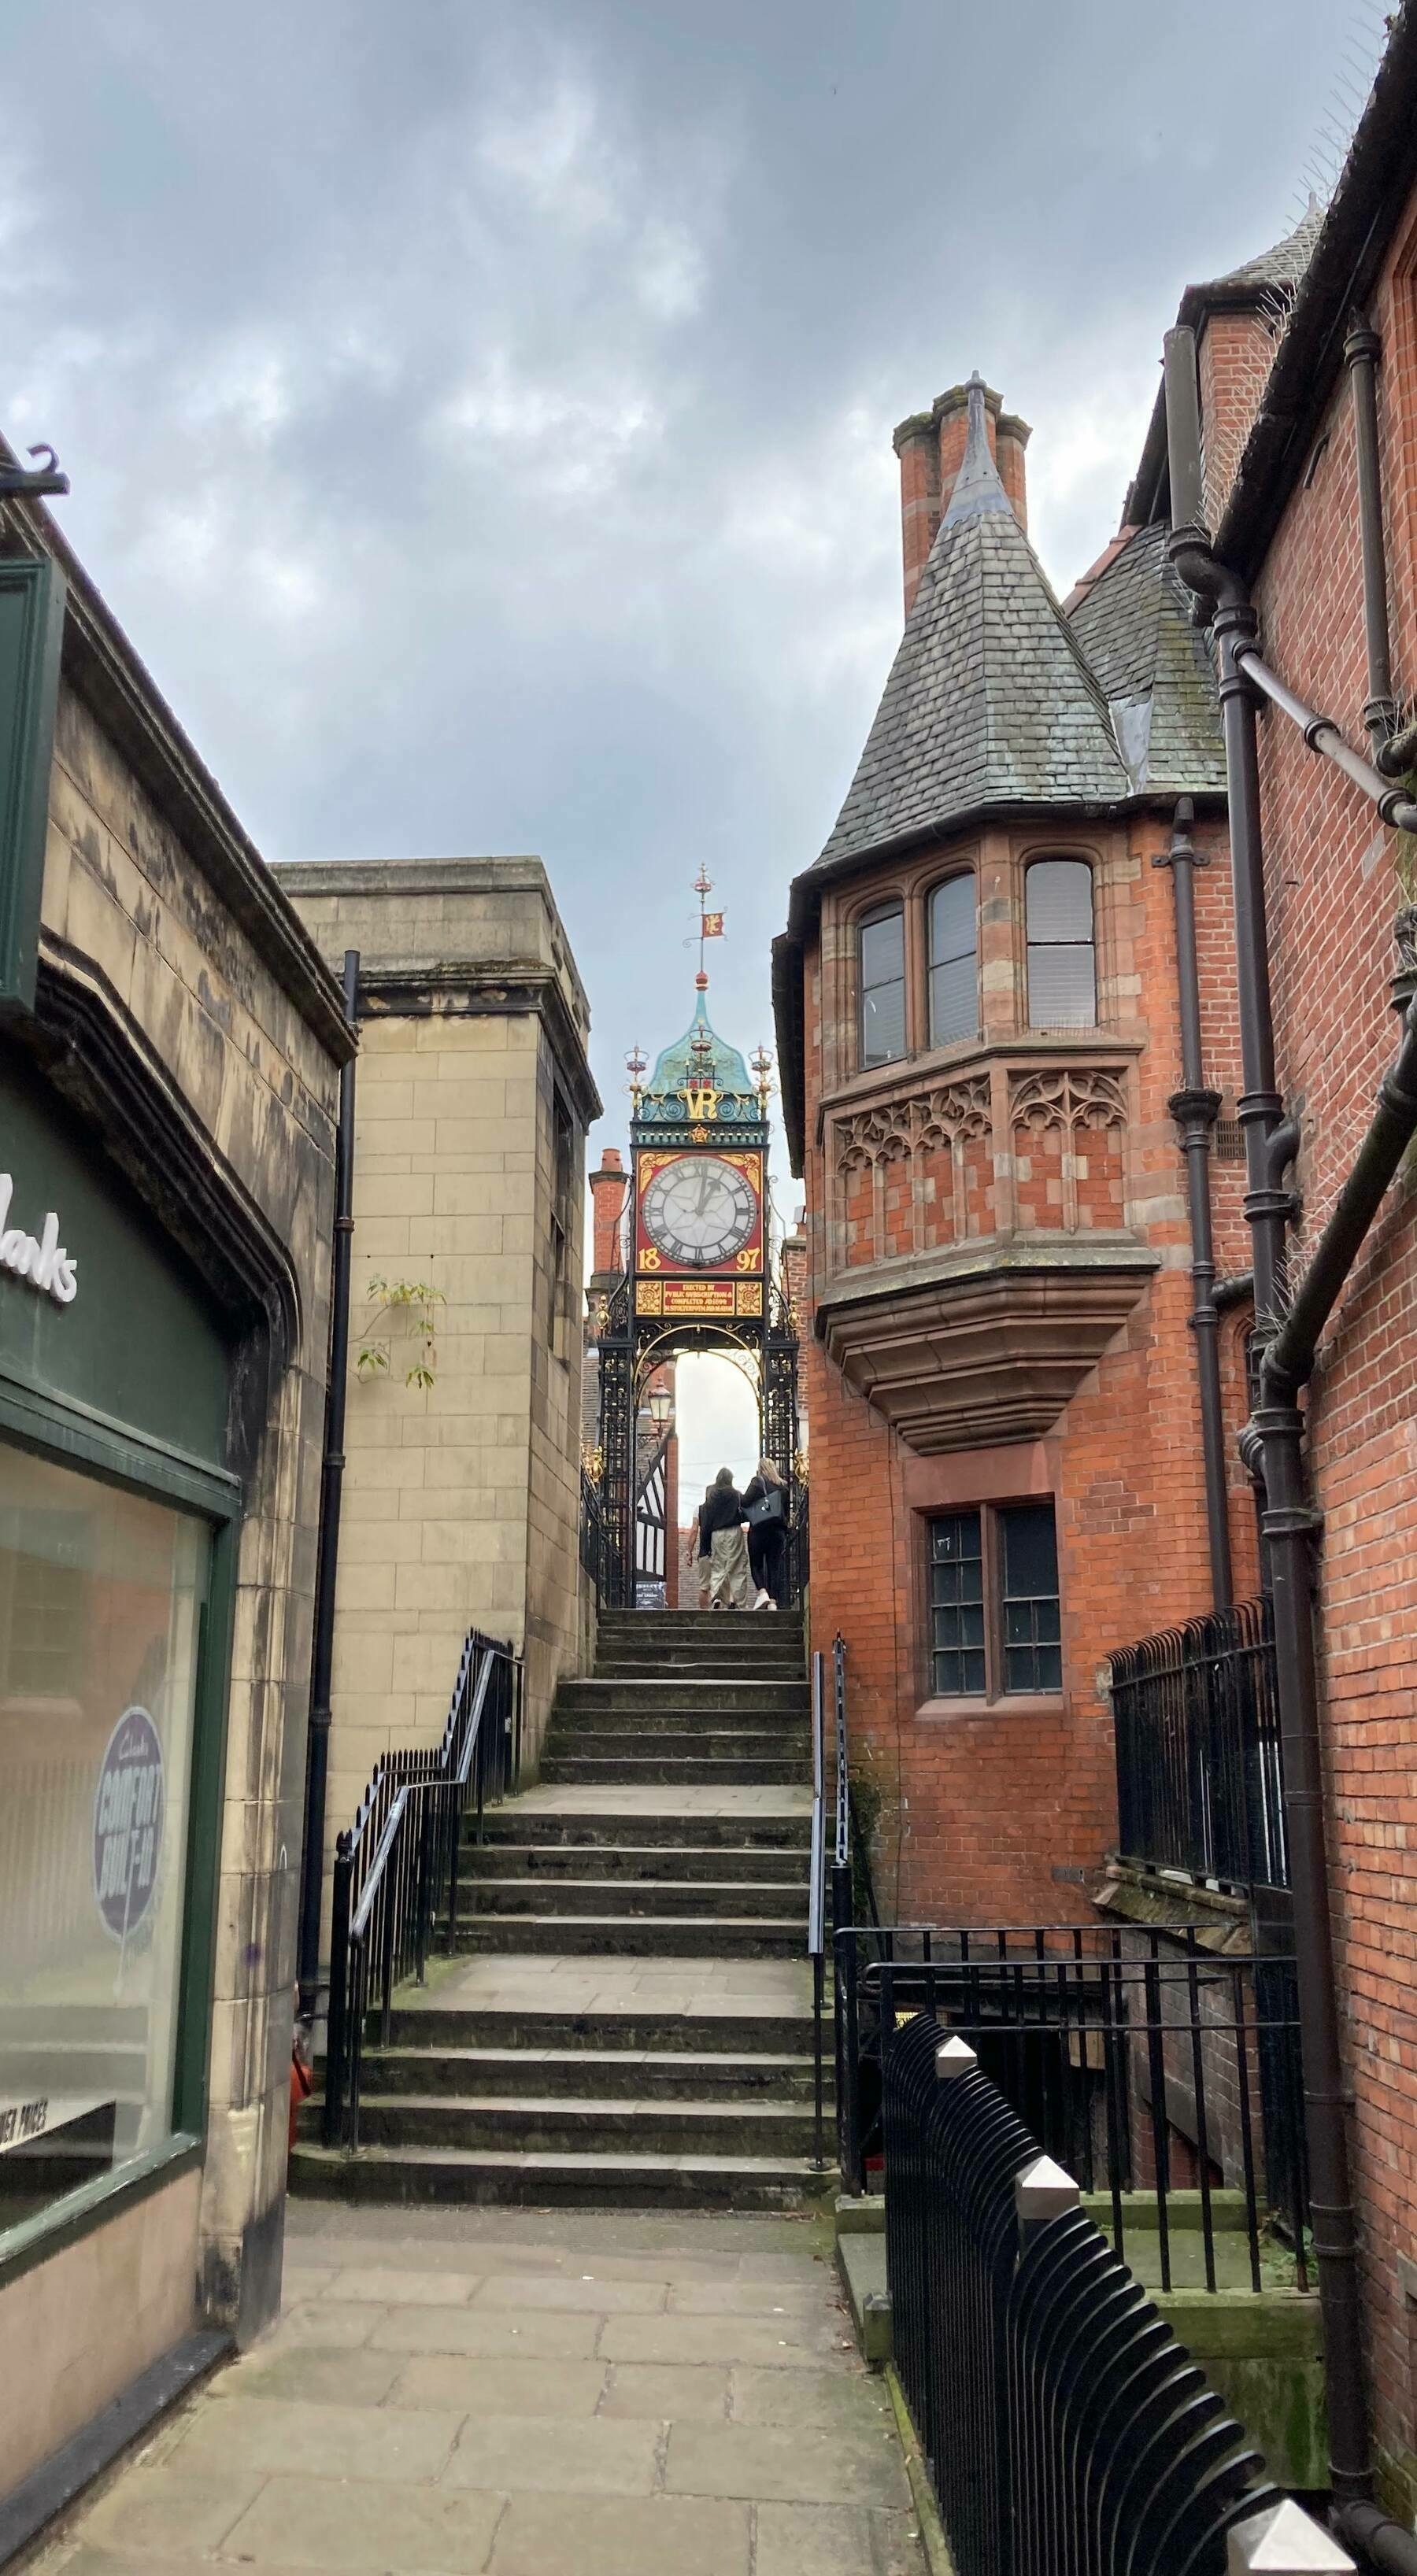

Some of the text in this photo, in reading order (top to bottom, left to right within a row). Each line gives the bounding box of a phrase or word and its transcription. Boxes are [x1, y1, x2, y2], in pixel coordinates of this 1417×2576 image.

[683, 1088, 718, 1119] VR
[638, 1247, 760, 1271] 18 97
